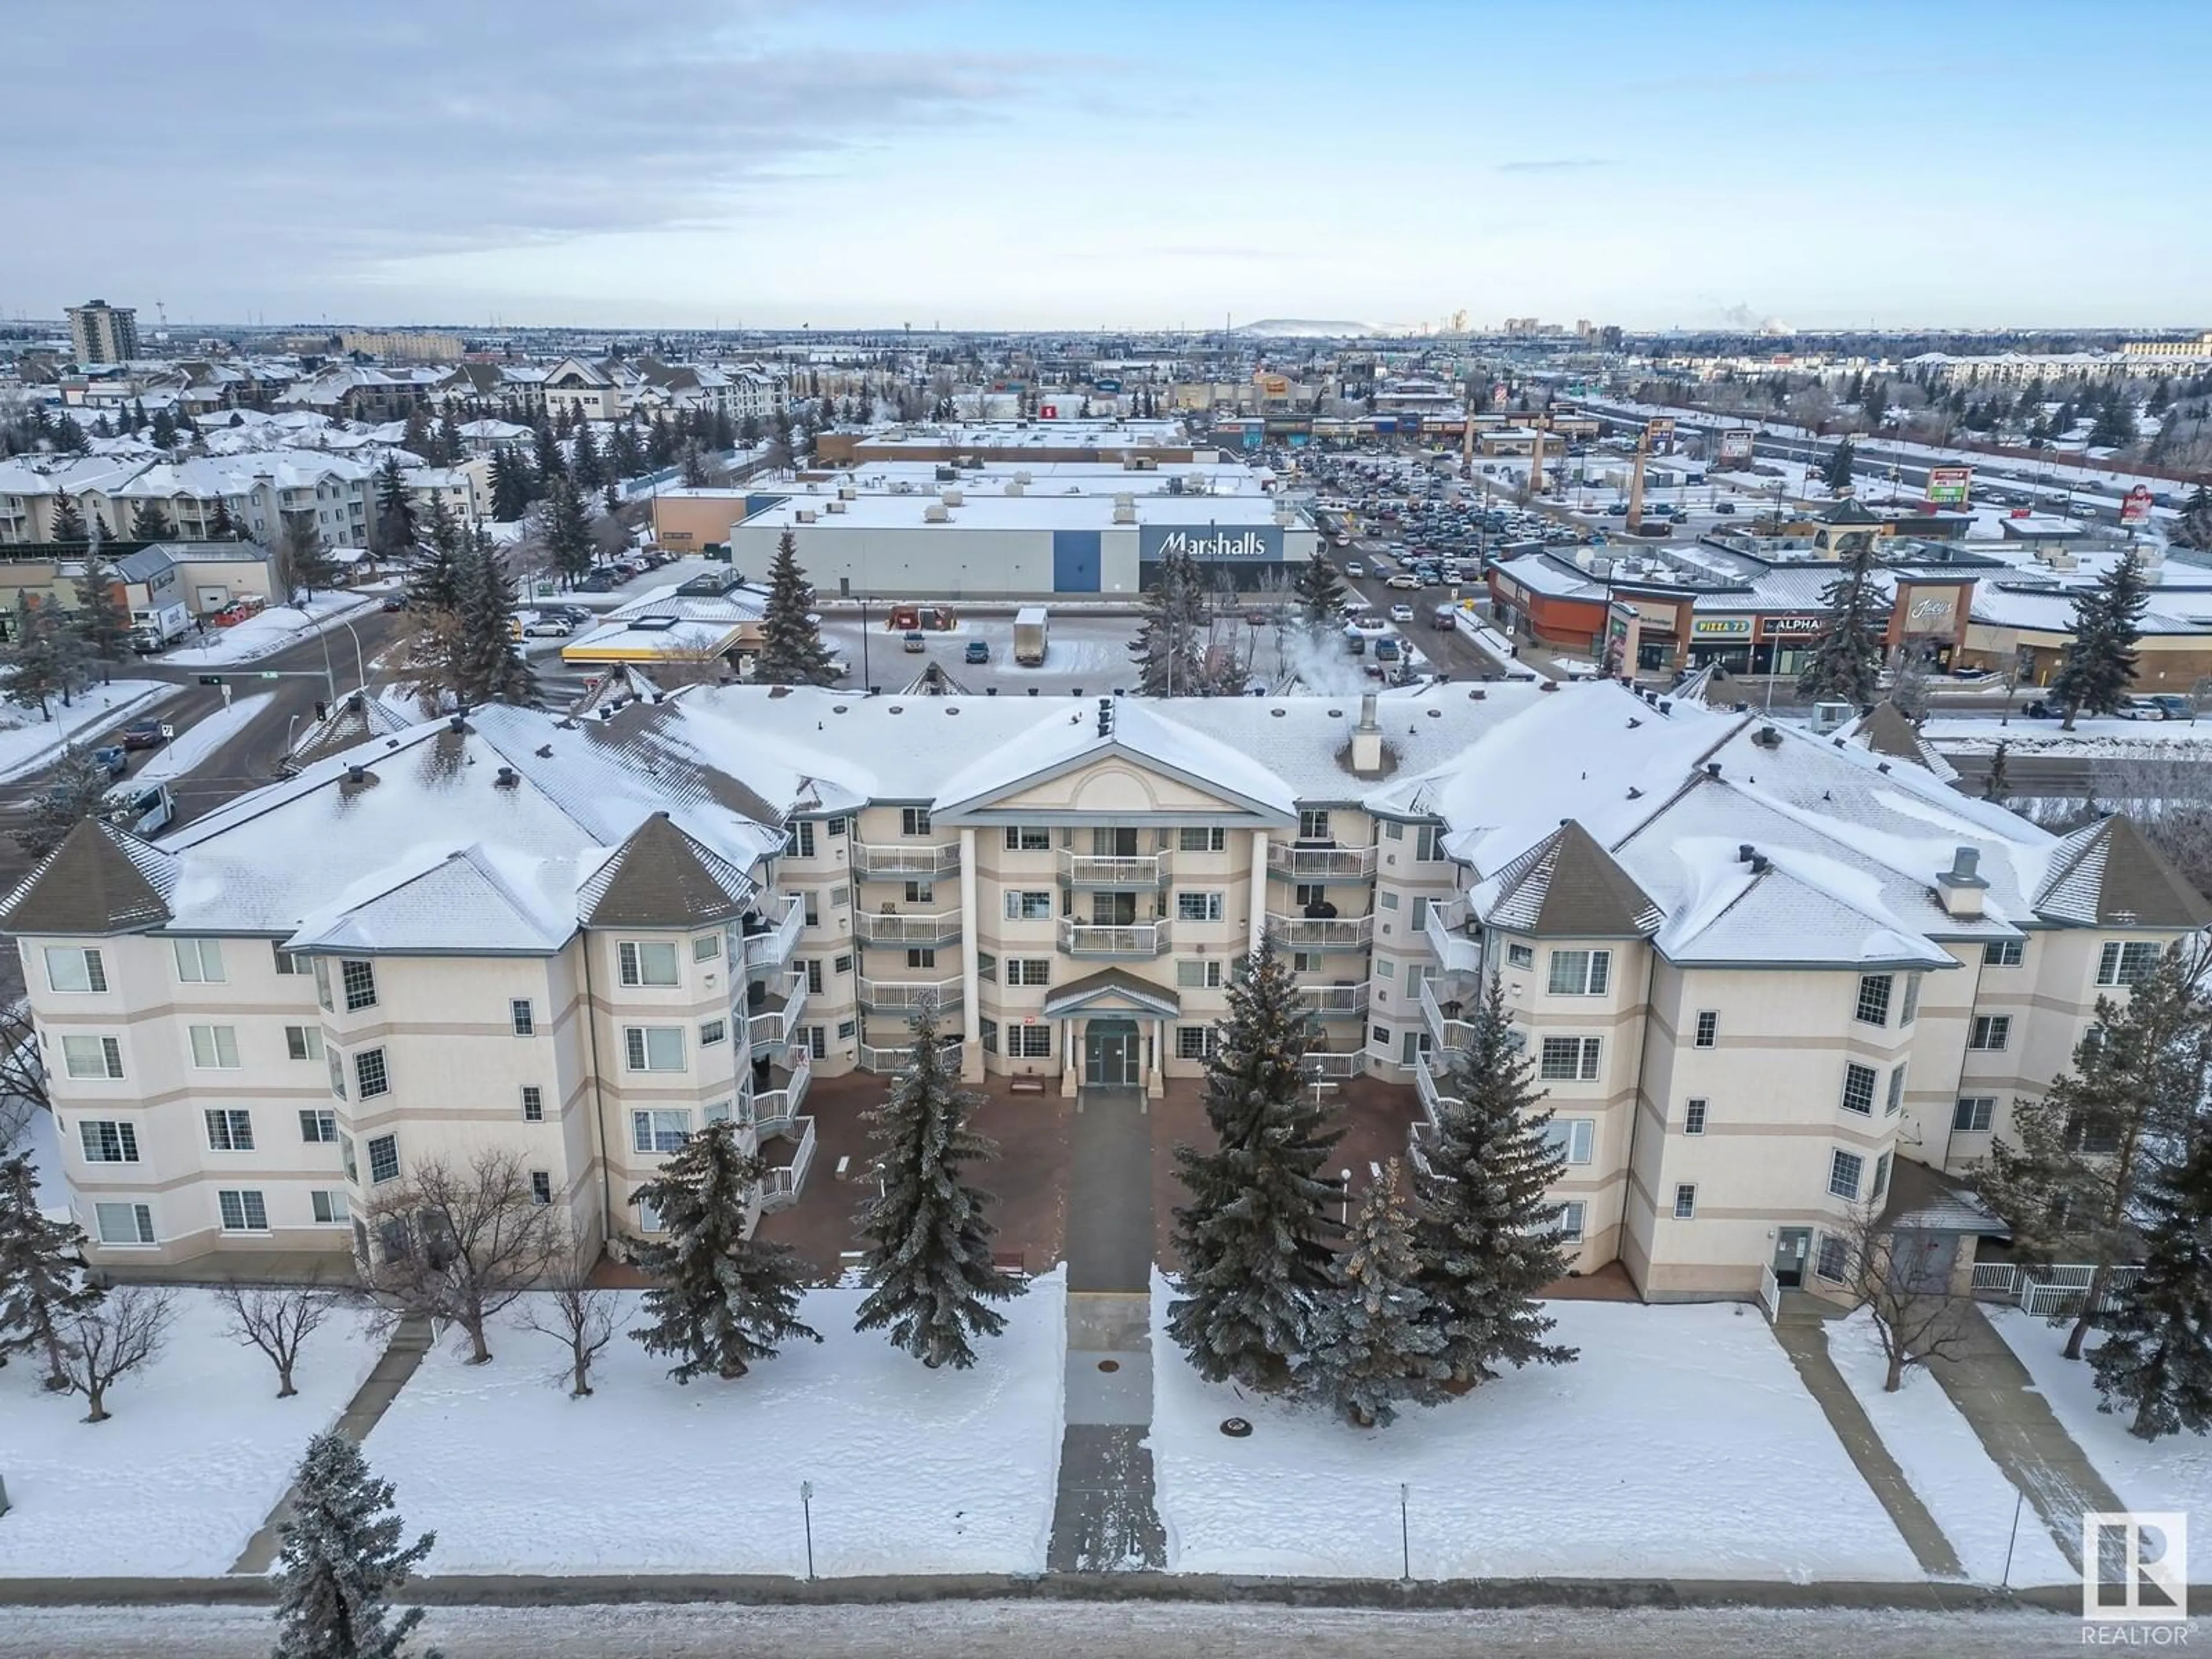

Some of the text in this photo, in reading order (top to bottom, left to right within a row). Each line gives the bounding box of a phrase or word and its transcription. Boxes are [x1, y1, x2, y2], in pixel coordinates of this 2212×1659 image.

[1158, 532, 1265, 555] Marshalls
[1699, 622, 1746, 631] PIZZA 73
